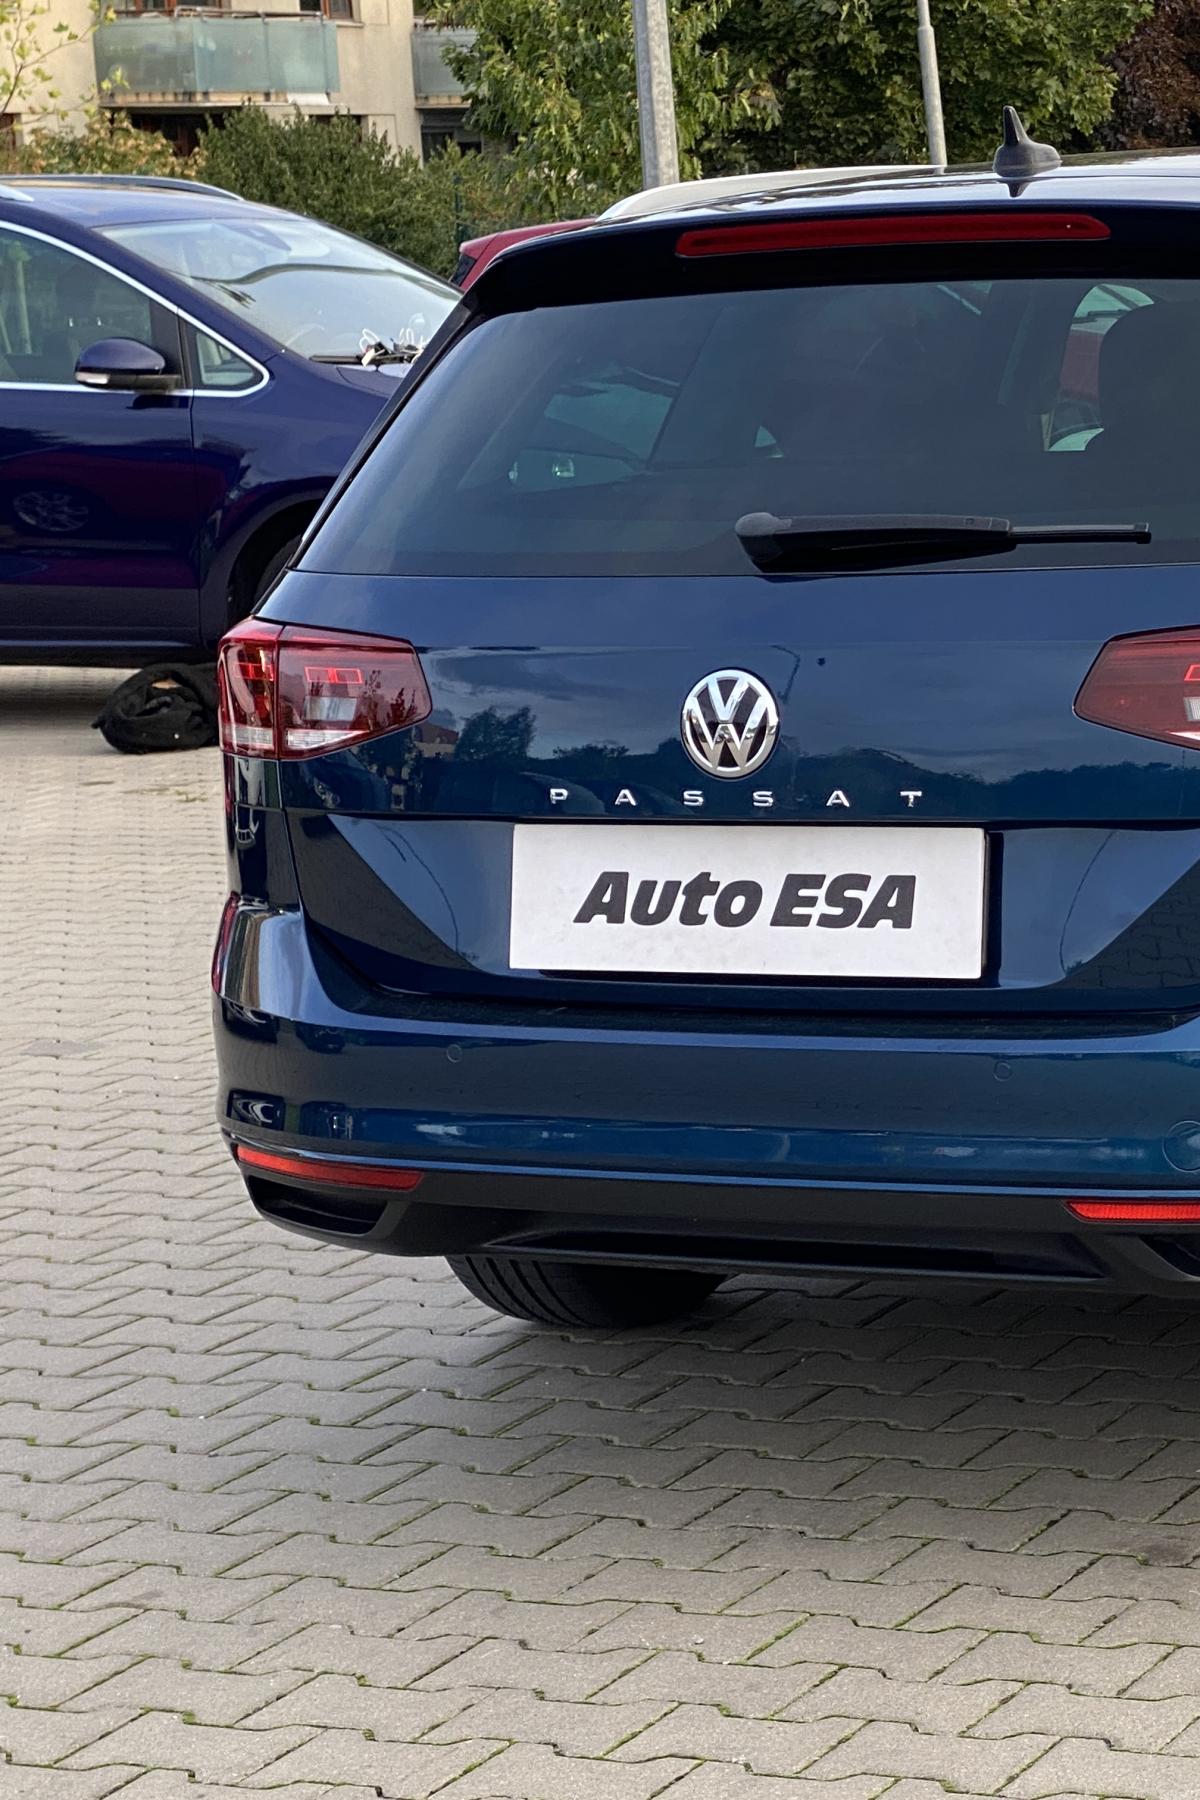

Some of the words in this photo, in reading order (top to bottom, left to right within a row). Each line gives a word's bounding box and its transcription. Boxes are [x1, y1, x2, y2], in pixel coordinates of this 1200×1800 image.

[683, 669, 779, 778] VW
[549, 788, 923, 808] PASSAT
[573, 871, 763, 928] Auto
[769, 873, 917, 929] ESA
